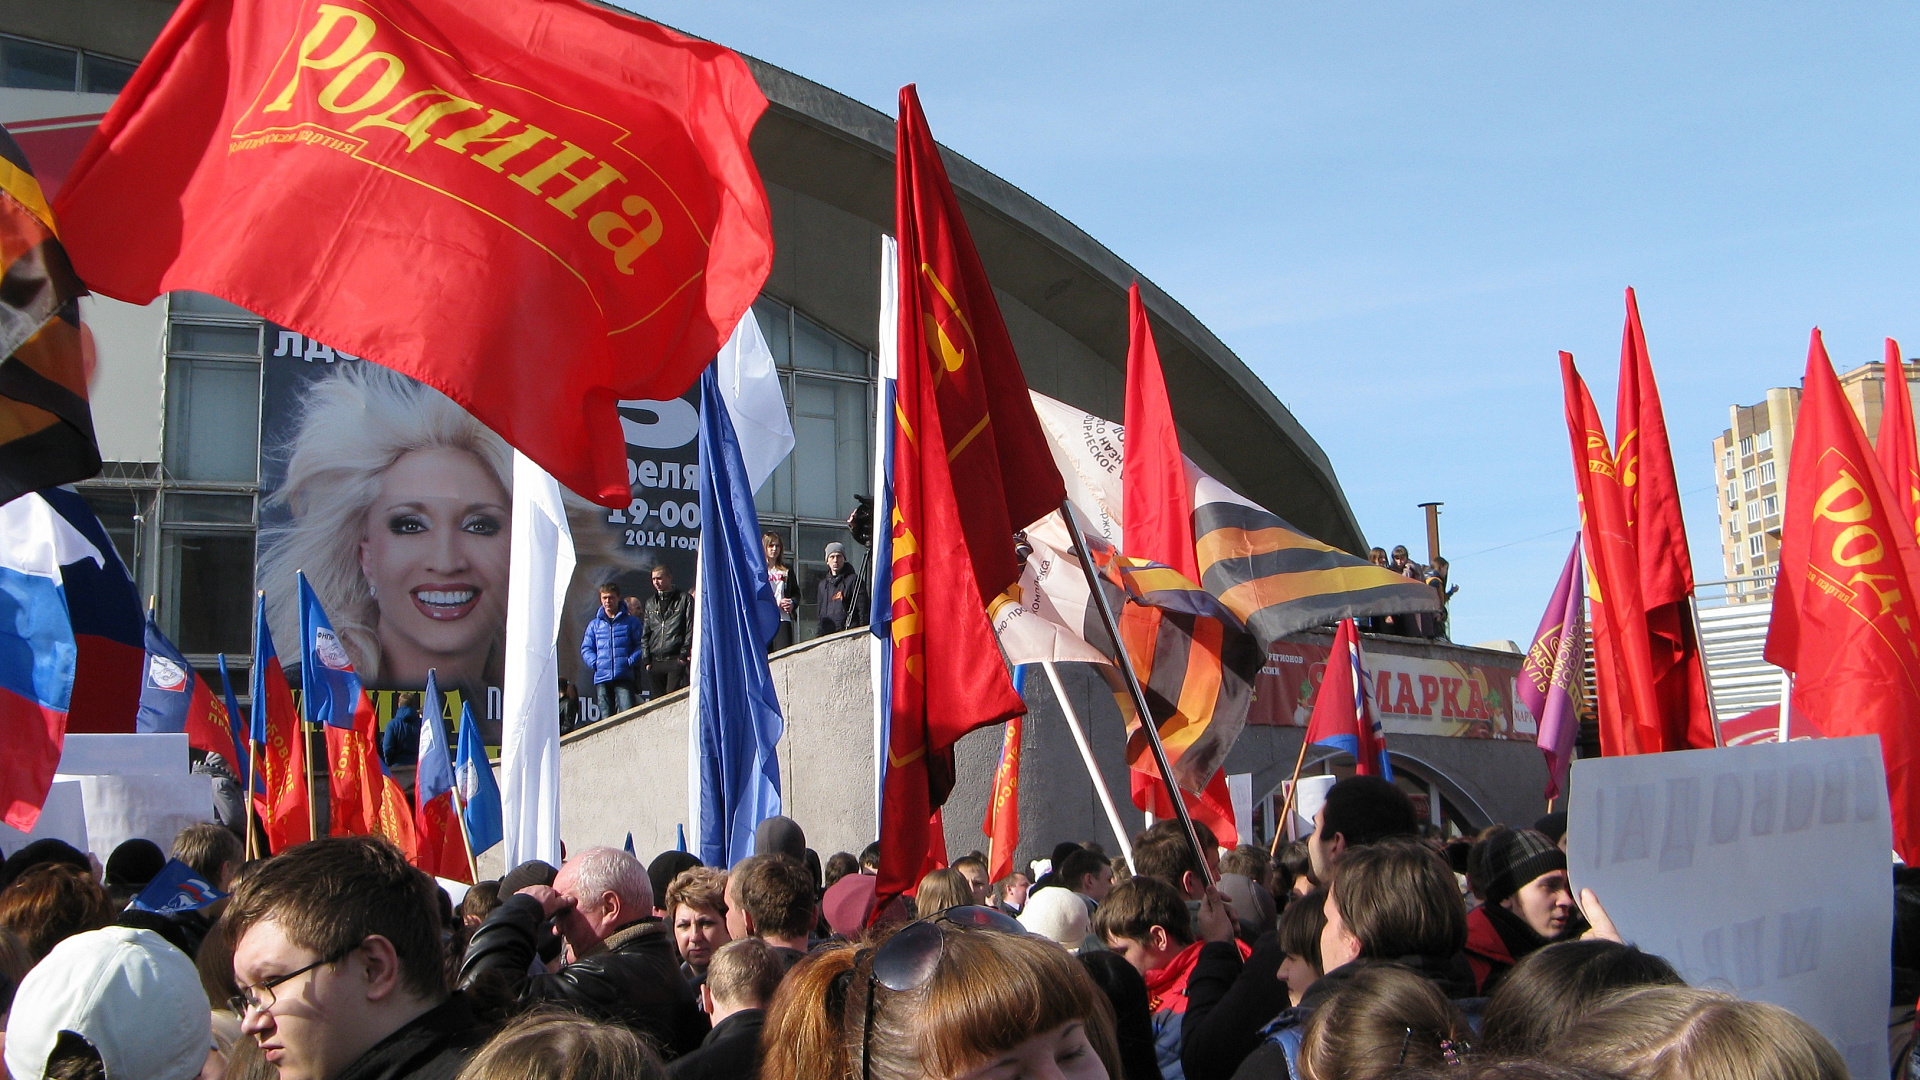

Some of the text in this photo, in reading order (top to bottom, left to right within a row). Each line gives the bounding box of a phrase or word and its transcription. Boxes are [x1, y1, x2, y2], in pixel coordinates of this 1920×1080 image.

[273, 330, 359, 363] ЛД
[625, 529, 666, 549] 2014
[1032, 560, 1051, 616] комплекса
[1268, 653, 1304, 664] РЕГИОНОВ
[1258, 665, 1280, 676] ССИИ
